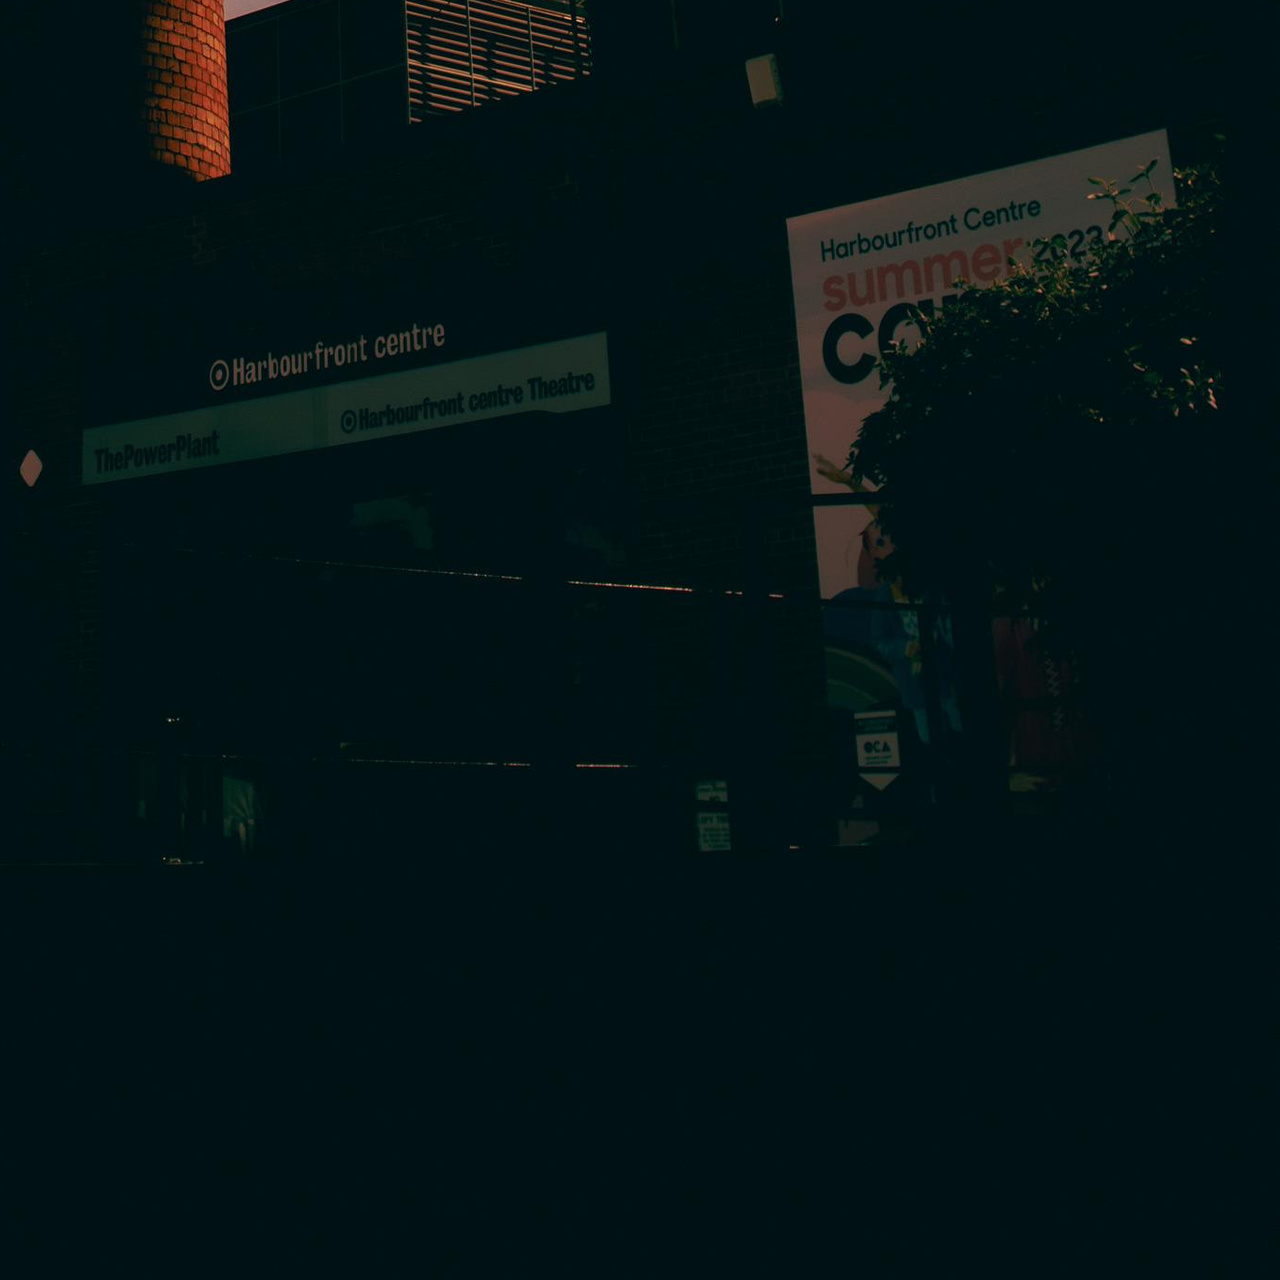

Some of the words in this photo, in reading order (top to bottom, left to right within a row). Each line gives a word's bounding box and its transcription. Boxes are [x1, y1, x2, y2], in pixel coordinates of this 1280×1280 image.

[820, 215, 957, 262] Harbourfront
[963, 197, 1042, 232] Centre
[822, 237, 1025, 312] summer
[232, 334, 368, 387] Harbourfront
[374, 322, 446, 360] centre
[359, 391, 465, 432] Harbourfront
[468, 378, 523, 411] centre
[527, 369, 595, 402] Theatre
